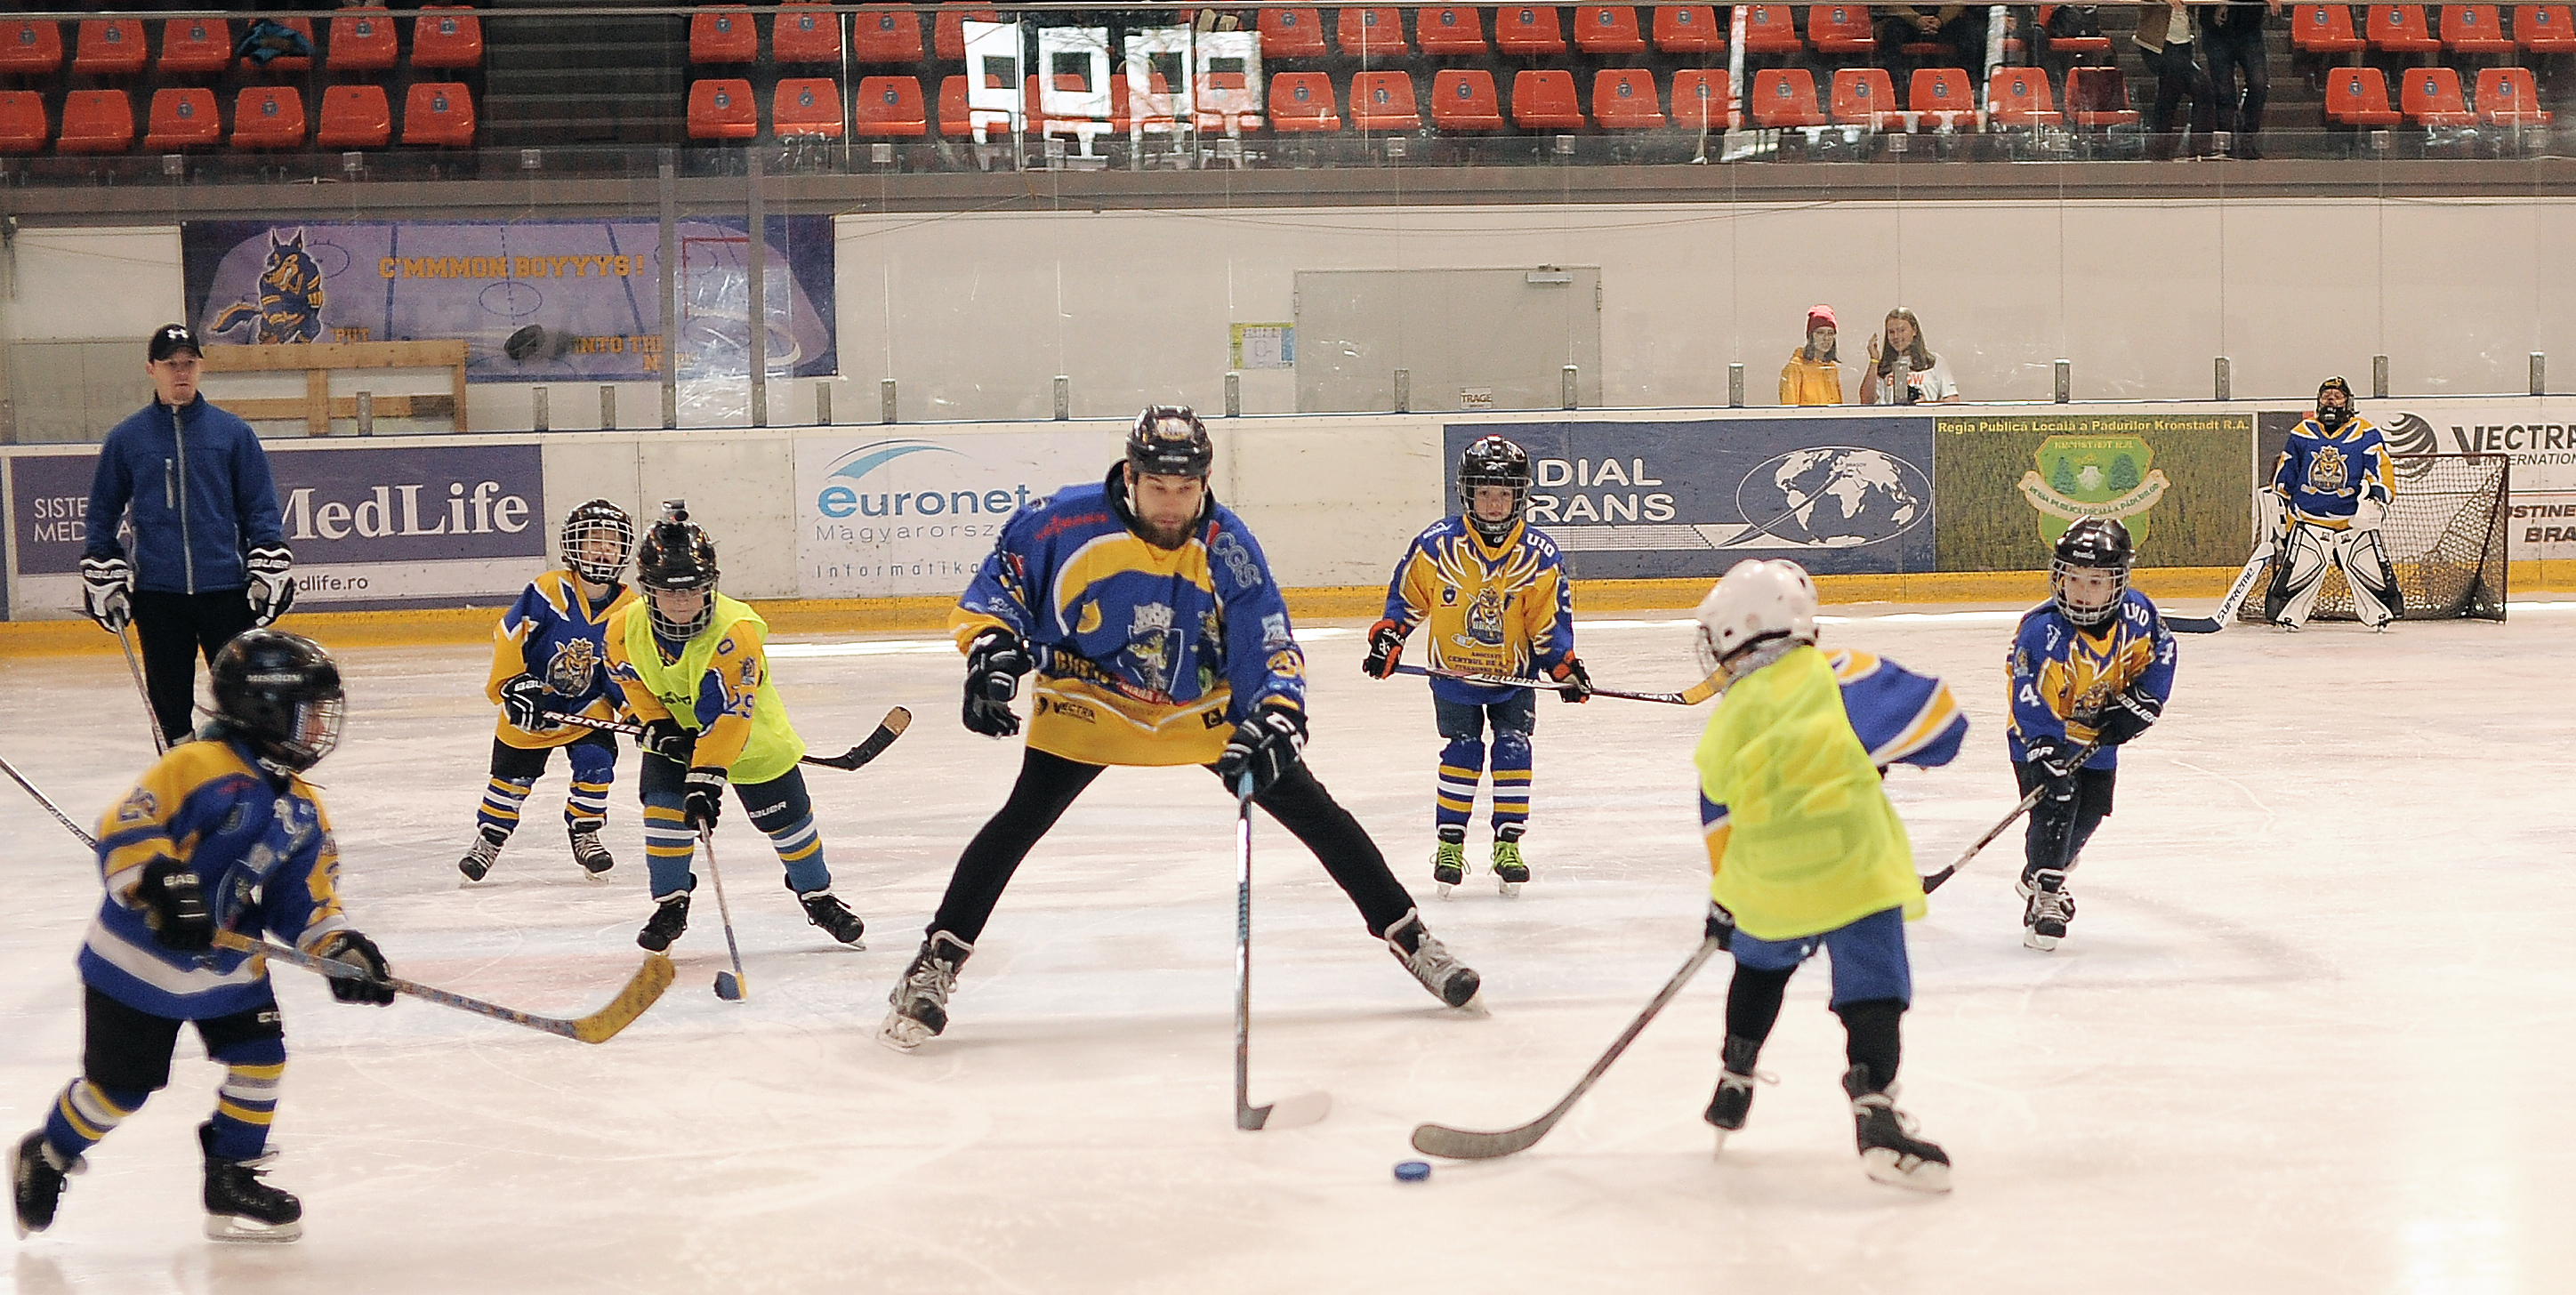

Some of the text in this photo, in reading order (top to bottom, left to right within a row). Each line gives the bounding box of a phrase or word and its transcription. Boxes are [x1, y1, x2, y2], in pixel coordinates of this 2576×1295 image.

[629, 335, 662, 353] TH
[1460, 393, 1493, 403] TRAGE
[1937, 422, 1976, 434] Regia
[2080, 422, 2089, 431] a
[2154, 420, 2219, 430] Kronstadt
[2224, 420, 2250, 430] R.A.
[1531, 458, 1663, 487] DIAL
[34, 497, 90, 519] SISTE
[278, 480, 530, 541] MedLife
[817, 483, 1031, 519] euronet
[1526, 493, 1677, 523] RANS
[816, 523, 995, 544] Magyarorsz
[1526, 533, 1556, 559] U10
[294, 575, 369, 591] dlife.ro
[2019, 683, 2041, 707] 4
[542, 711, 643, 735] RONTIE
[164, 873, 199, 887] EAS
